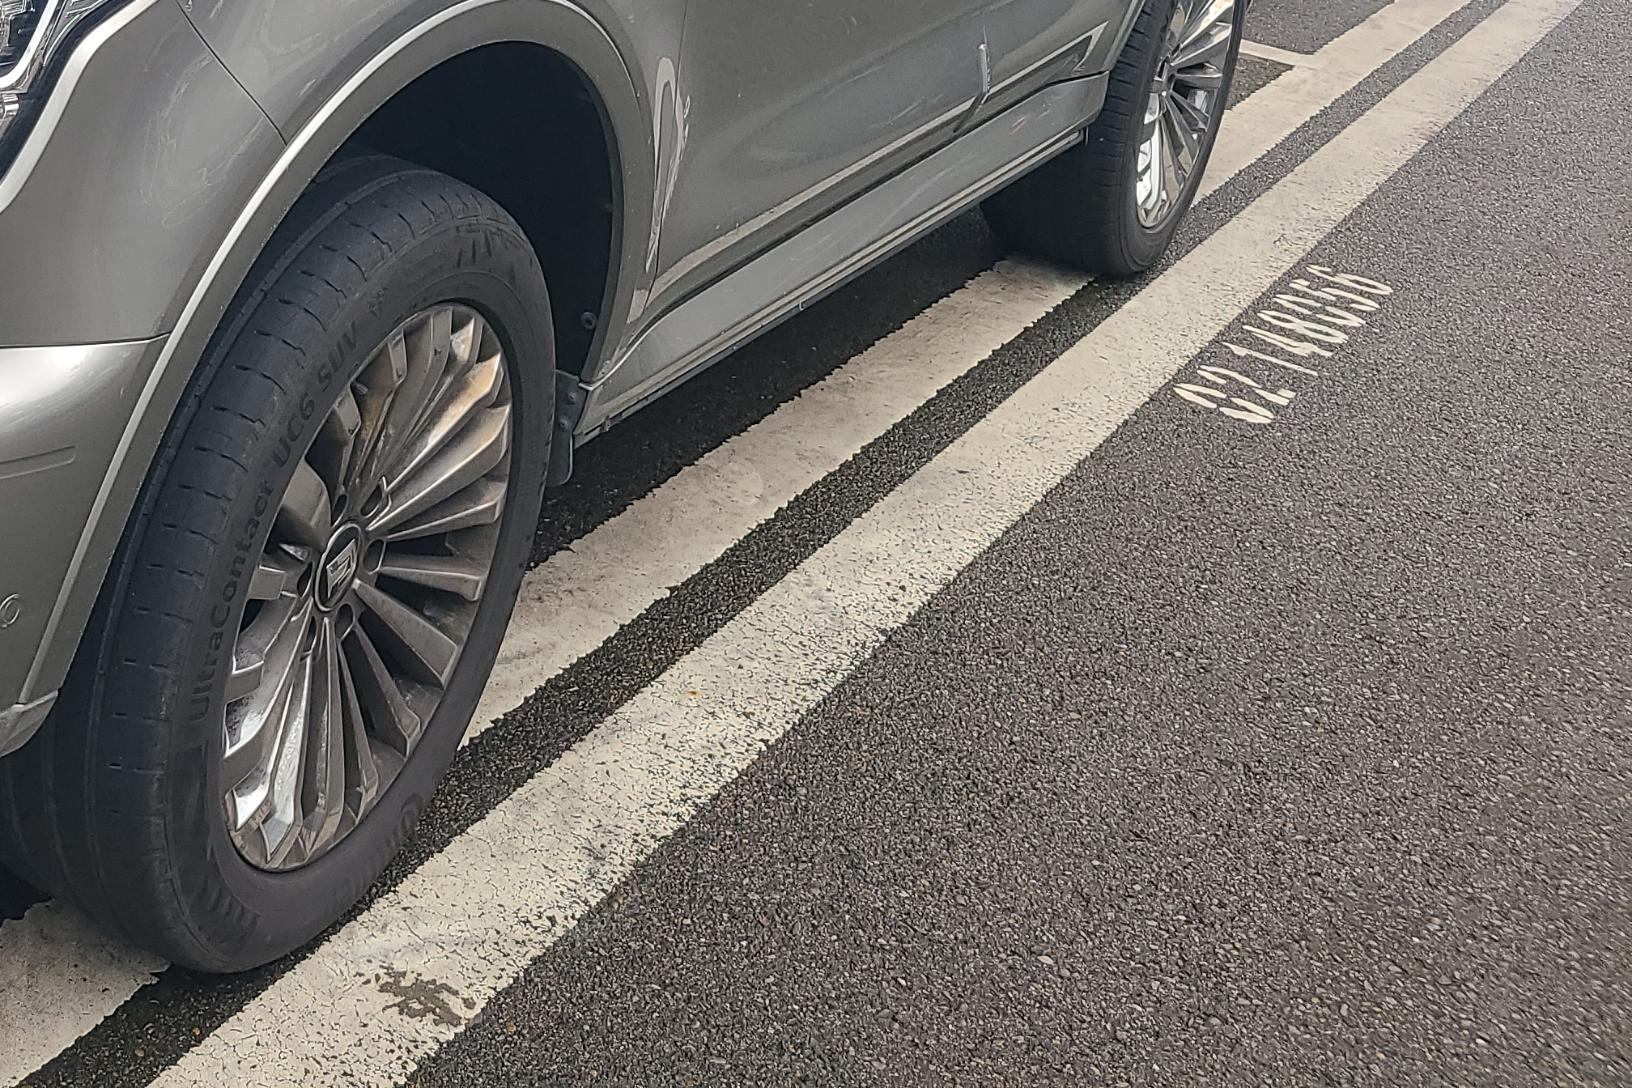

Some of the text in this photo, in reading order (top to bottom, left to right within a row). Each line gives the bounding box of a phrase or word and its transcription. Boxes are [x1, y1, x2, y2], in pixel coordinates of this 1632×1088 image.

[189, 322, 360, 723] UltraContact UC6 SUV
